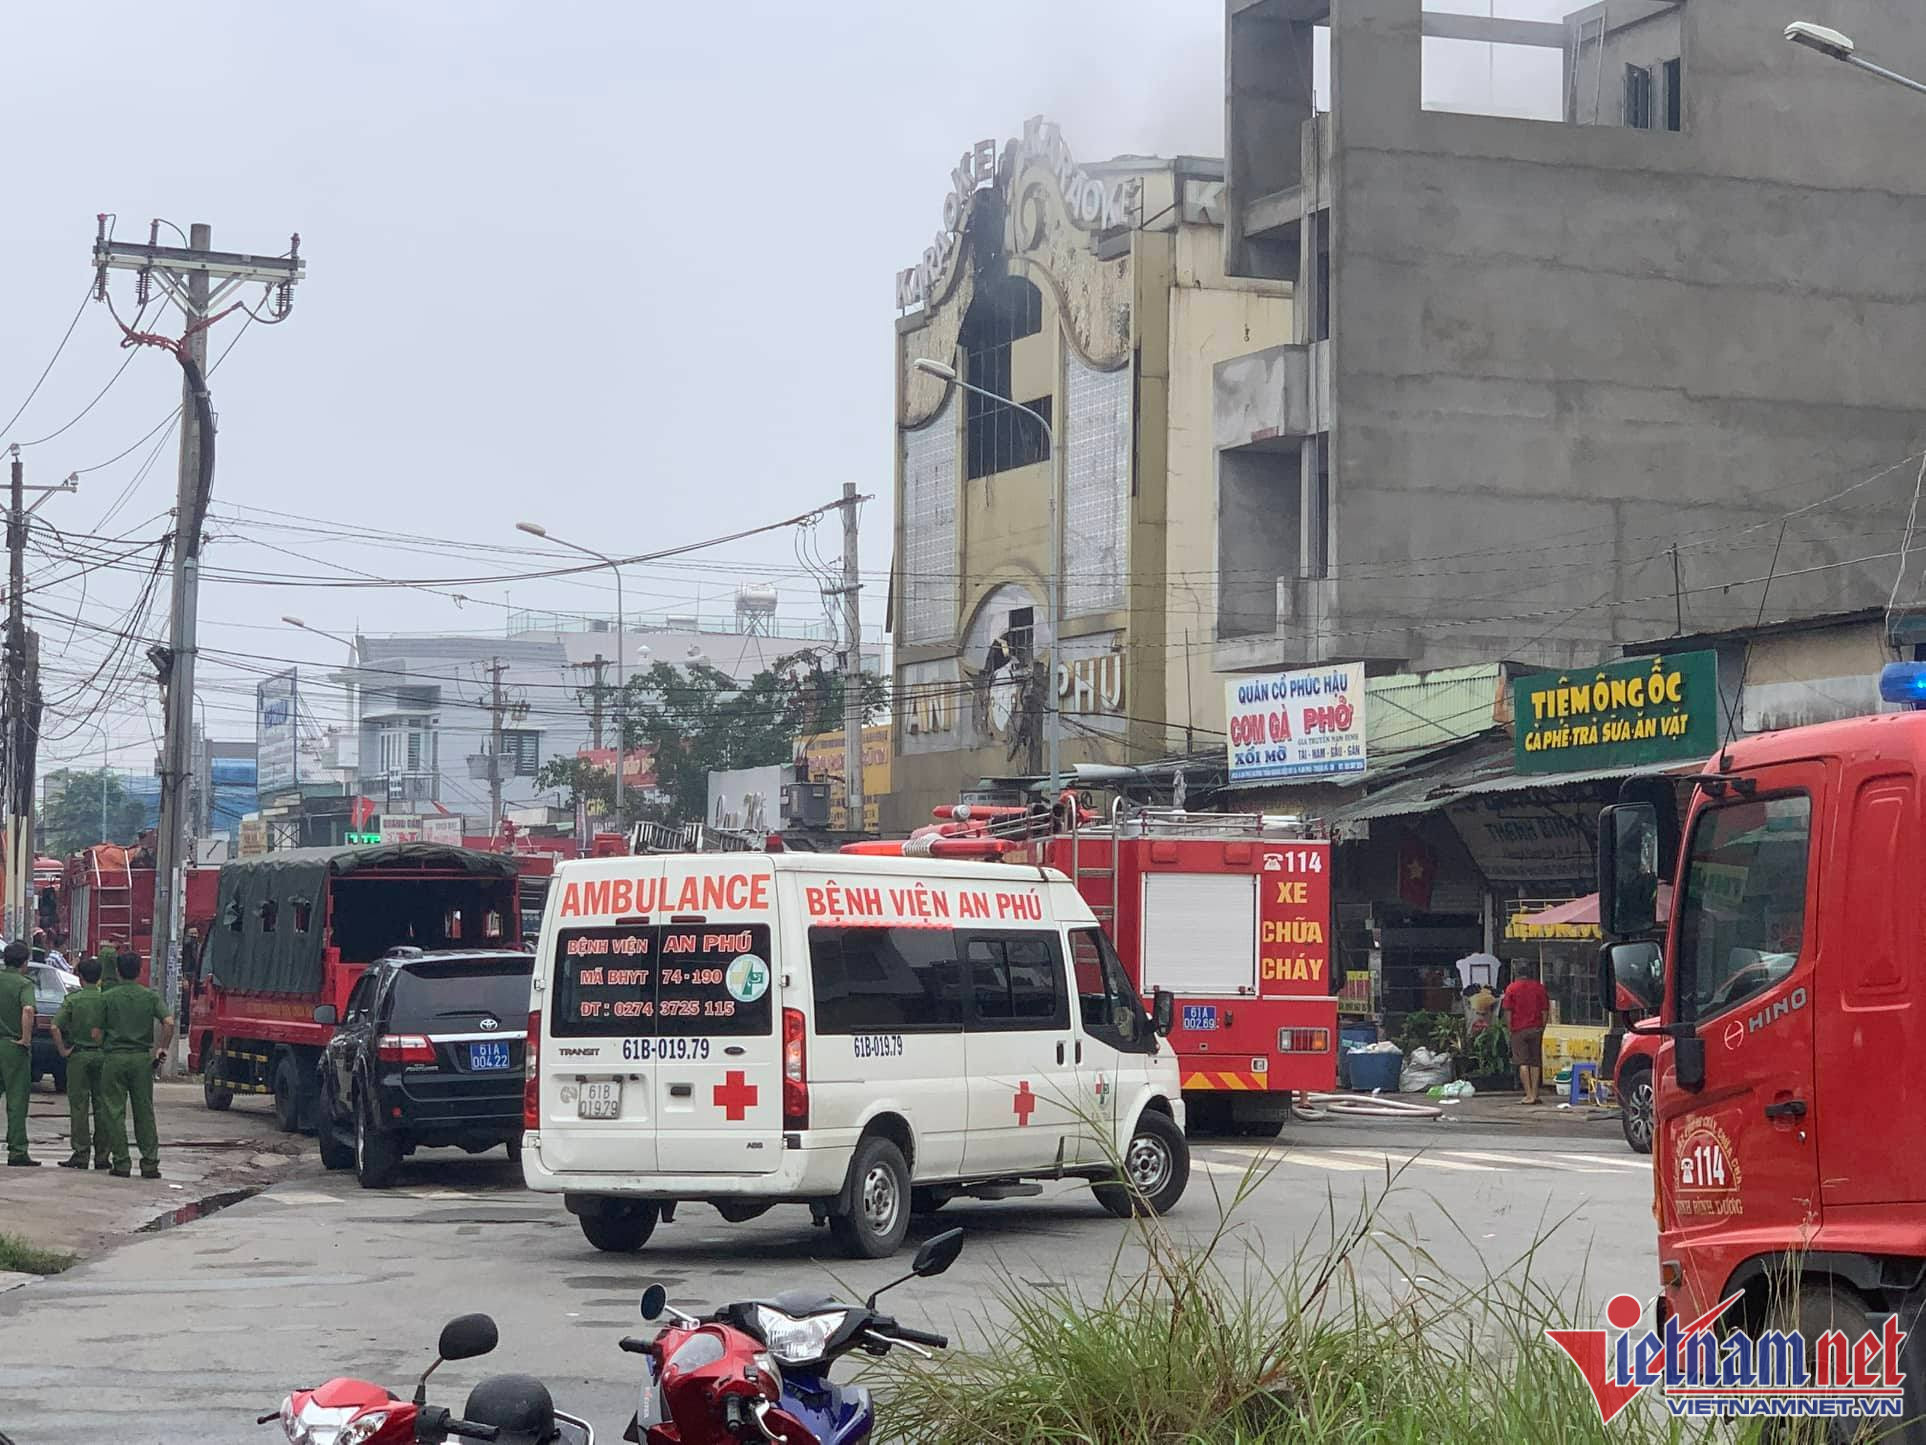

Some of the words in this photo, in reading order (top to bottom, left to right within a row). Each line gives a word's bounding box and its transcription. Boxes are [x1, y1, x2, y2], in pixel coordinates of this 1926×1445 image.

[1290, 674, 1320, 698] PHÚC
[1593, 672, 1645, 712] ÔNG
[1648, 657, 1682, 704] ỐC
[1269, 704, 1292, 744] GÀ
[1304, 695, 1354, 735] PHỞ
[1285, 851, 1322, 873] 114
[560, 874, 771, 917] AMBULANCE
[806, 879, 883, 922] BỆNH
[889, 882, 949, 923] VIỆN
[959, 891, 991, 919] AN
[996, 888, 1043, 921] PHÚ
[1276, 882, 1308, 904] XE
[567, 936, 608, 957] BỆNH
[612, 936, 648, 957] VIỆN
[663, 935, 696, 953] AN
[703, 930, 753, 953] PHÚ
[1262, 917, 1323, 945] CHỮA
[607, 970, 649, 984] BHYT
[1262, 953, 1324, 981] CHÁY
[614, 1002, 653, 1016] 0274
[660, 1001, 700, 1016] 3725
[704, 1001, 735, 1016] 115
[1750, 987, 1807, 1033] HINO
[558, 1048, 600, 1057] TRANSIT
[623, 1038, 709, 1061] 61B-019.79
[854, 1035, 903, 1058] 61B-019.79
[589, 1084, 610, 1099] 61B
[1694, 1145, 1725, 1186] 114
